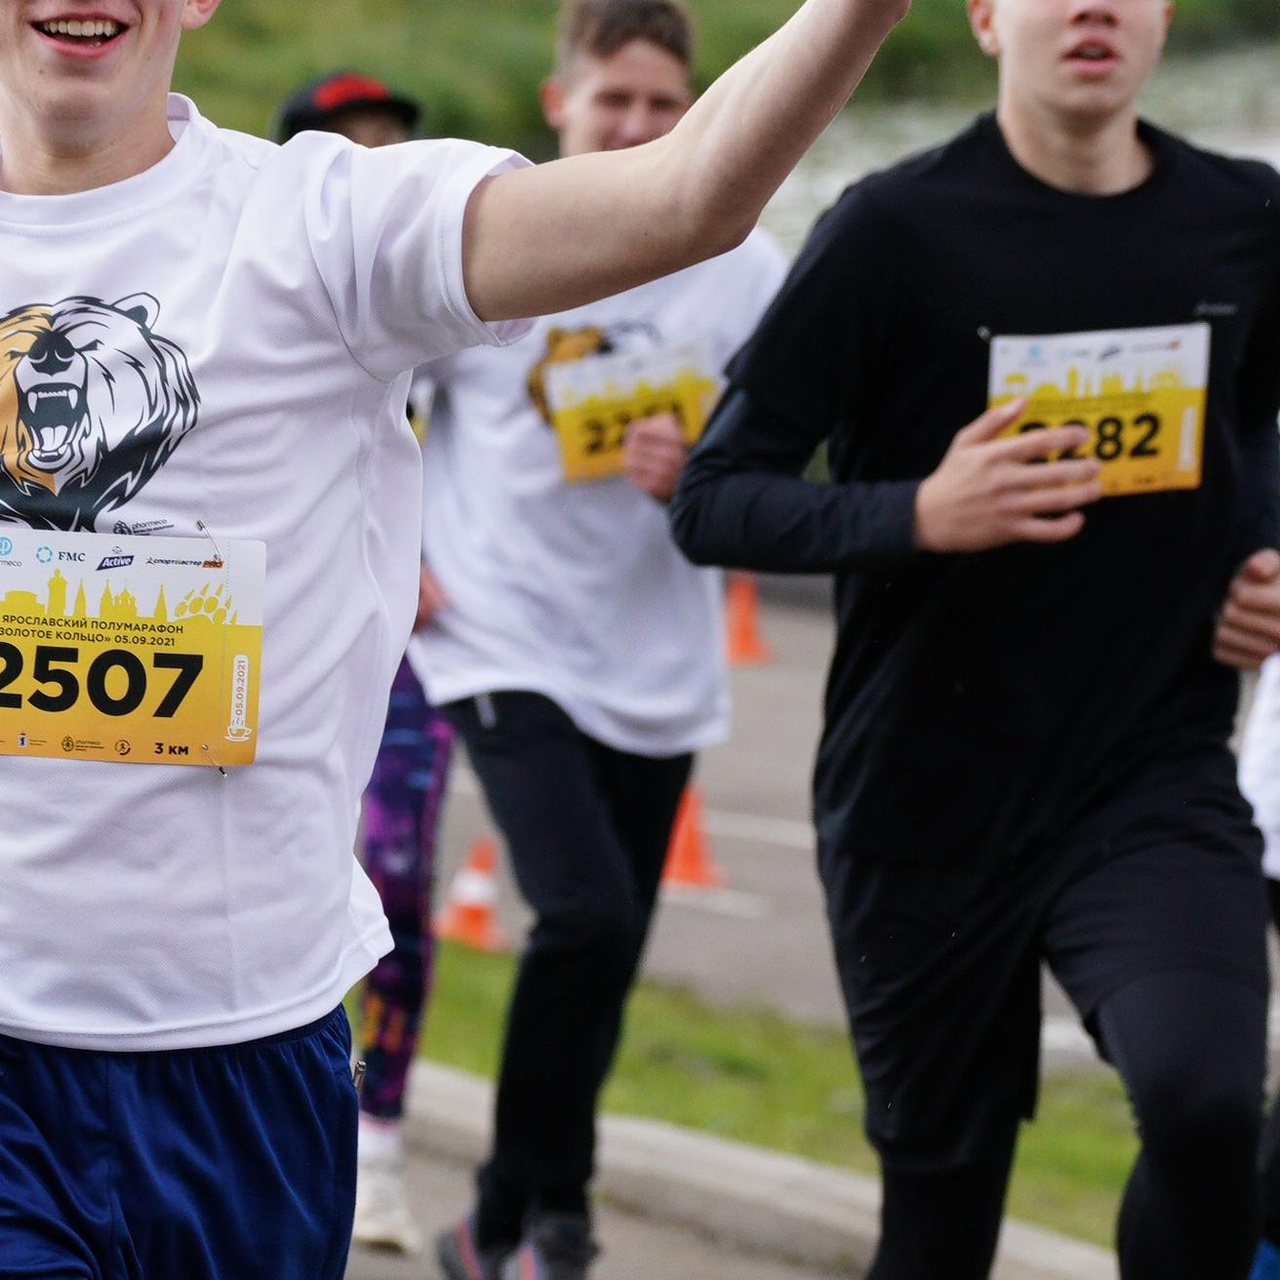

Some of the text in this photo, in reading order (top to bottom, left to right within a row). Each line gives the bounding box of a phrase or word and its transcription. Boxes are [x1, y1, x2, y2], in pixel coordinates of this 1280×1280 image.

[58, 551, 86, 562] FMC
[102, 556, 132, 568] Active
[2, 614, 88, 629] ЯРОСЛАВСКИЙ
[91, 620, 184, 634] ПОЛУМАРАФОН
[56, 631, 111, 643] КОЛЬЦО»
[114, 634, 175, 647] 05.09.2021
[235, 659, 246, 716] 05.09.2021
[154, 742, 164, 755] 3
